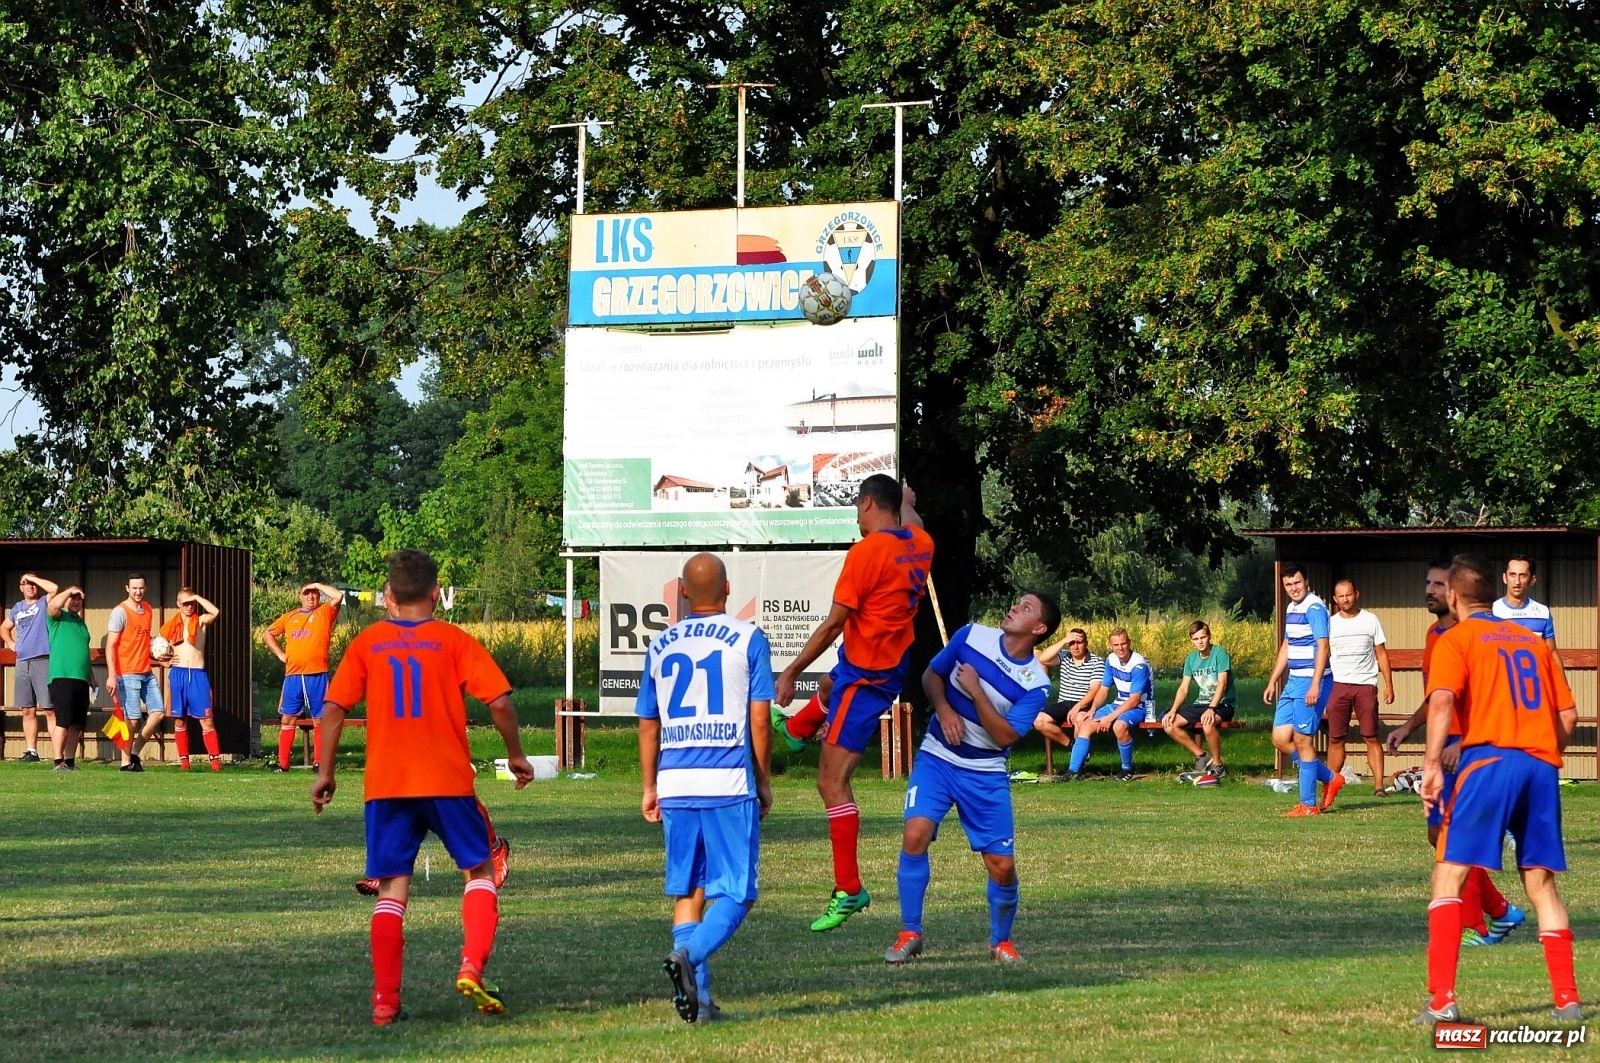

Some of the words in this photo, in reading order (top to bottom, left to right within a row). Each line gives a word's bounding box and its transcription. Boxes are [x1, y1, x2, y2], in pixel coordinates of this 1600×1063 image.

[595, 217, 653, 264] LKS
[816, 211, 883, 254] GRZEGORZOWICE
[619, 360, 679, 374] rozwiązania
[682, 359, 697, 371] dla
[700, 358, 749, 370] rolnictwa
[758, 355, 812, 371] przemysłu
[858, 342, 884, 358] wolf
[623, 520, 661, 528] odwiedzenia
[662, 520, 687, 529] naszego
[769, 518, 807, 528] wzorcowego
[610, 603, 669, 649] RS
[763, 600, 780, 612] RS
[783, 600, 810, 612] BAU
[653, 627, 679, 655] LKS
[684, 623, 741, 647] ZGODA
[388, 655, 422, 719] 11
[661, 649, 724, 720] 21
[1498, 648, 1541, 710] 18
